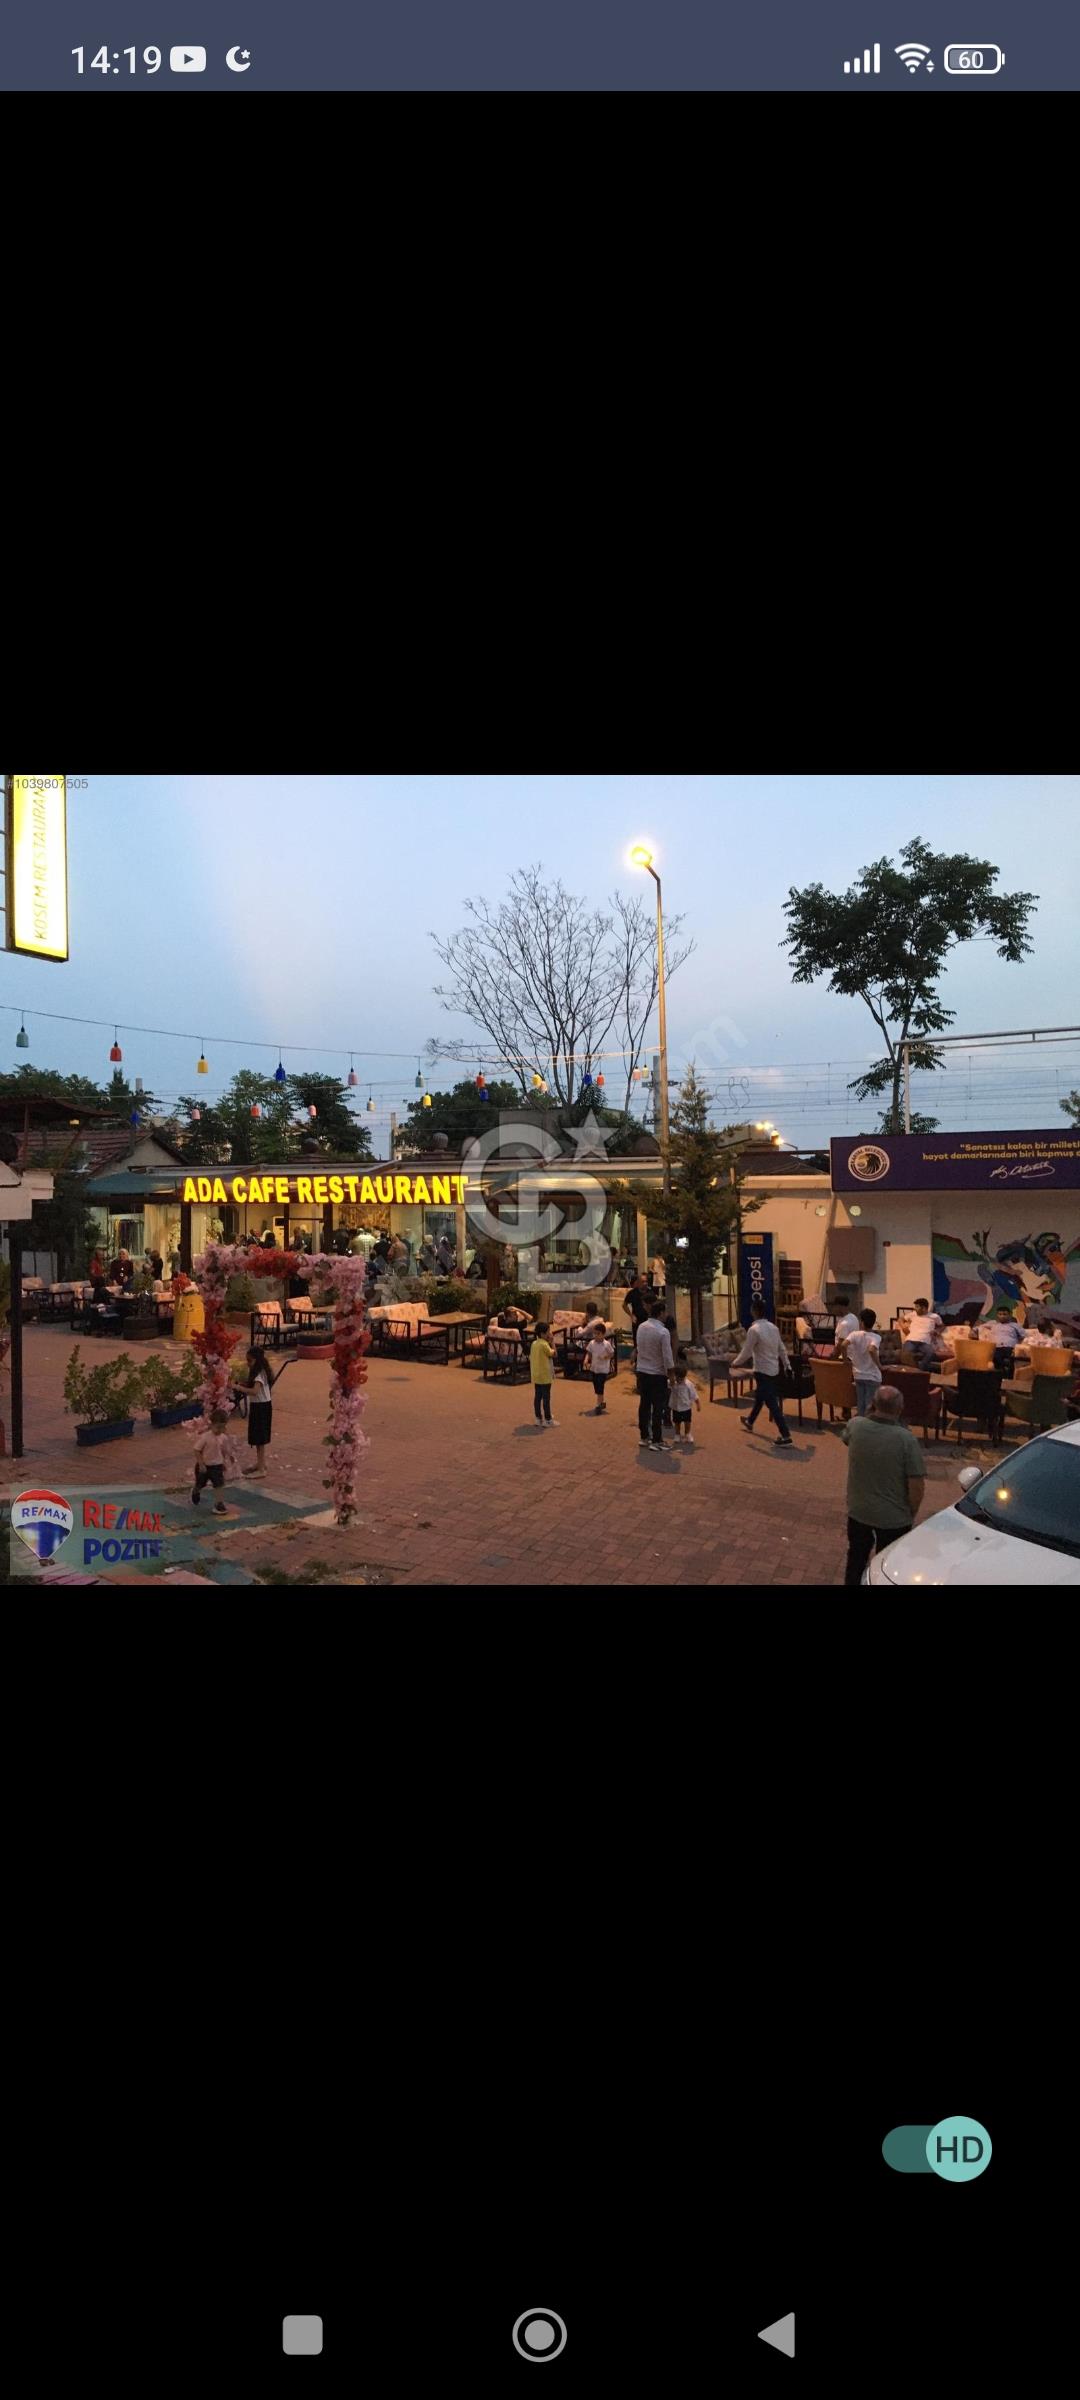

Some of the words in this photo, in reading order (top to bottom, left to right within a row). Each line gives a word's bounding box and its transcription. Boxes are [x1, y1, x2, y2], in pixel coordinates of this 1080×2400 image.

[71, 45, 162, 74] 14:19
[958, 51, 984, 69] 60
[922, 1152, 948, 1162] hayat
[950, 1150, 1018, 1160] damarlarından
[1019, 1150, 1036, 1159] biri
[1038, 1150, 1073, 1159] kopmuş
[1008, 1143, 1034, 1151] kalan
[1035, 1142, 1054, 1150] bir
[183, 1177, 227, 1202] ADA
[232, 1177, 290, 1203] CAFE
[297, 1175, 469, 1204] RESTAURANT
[936, 2136, 984, 2163] HD
